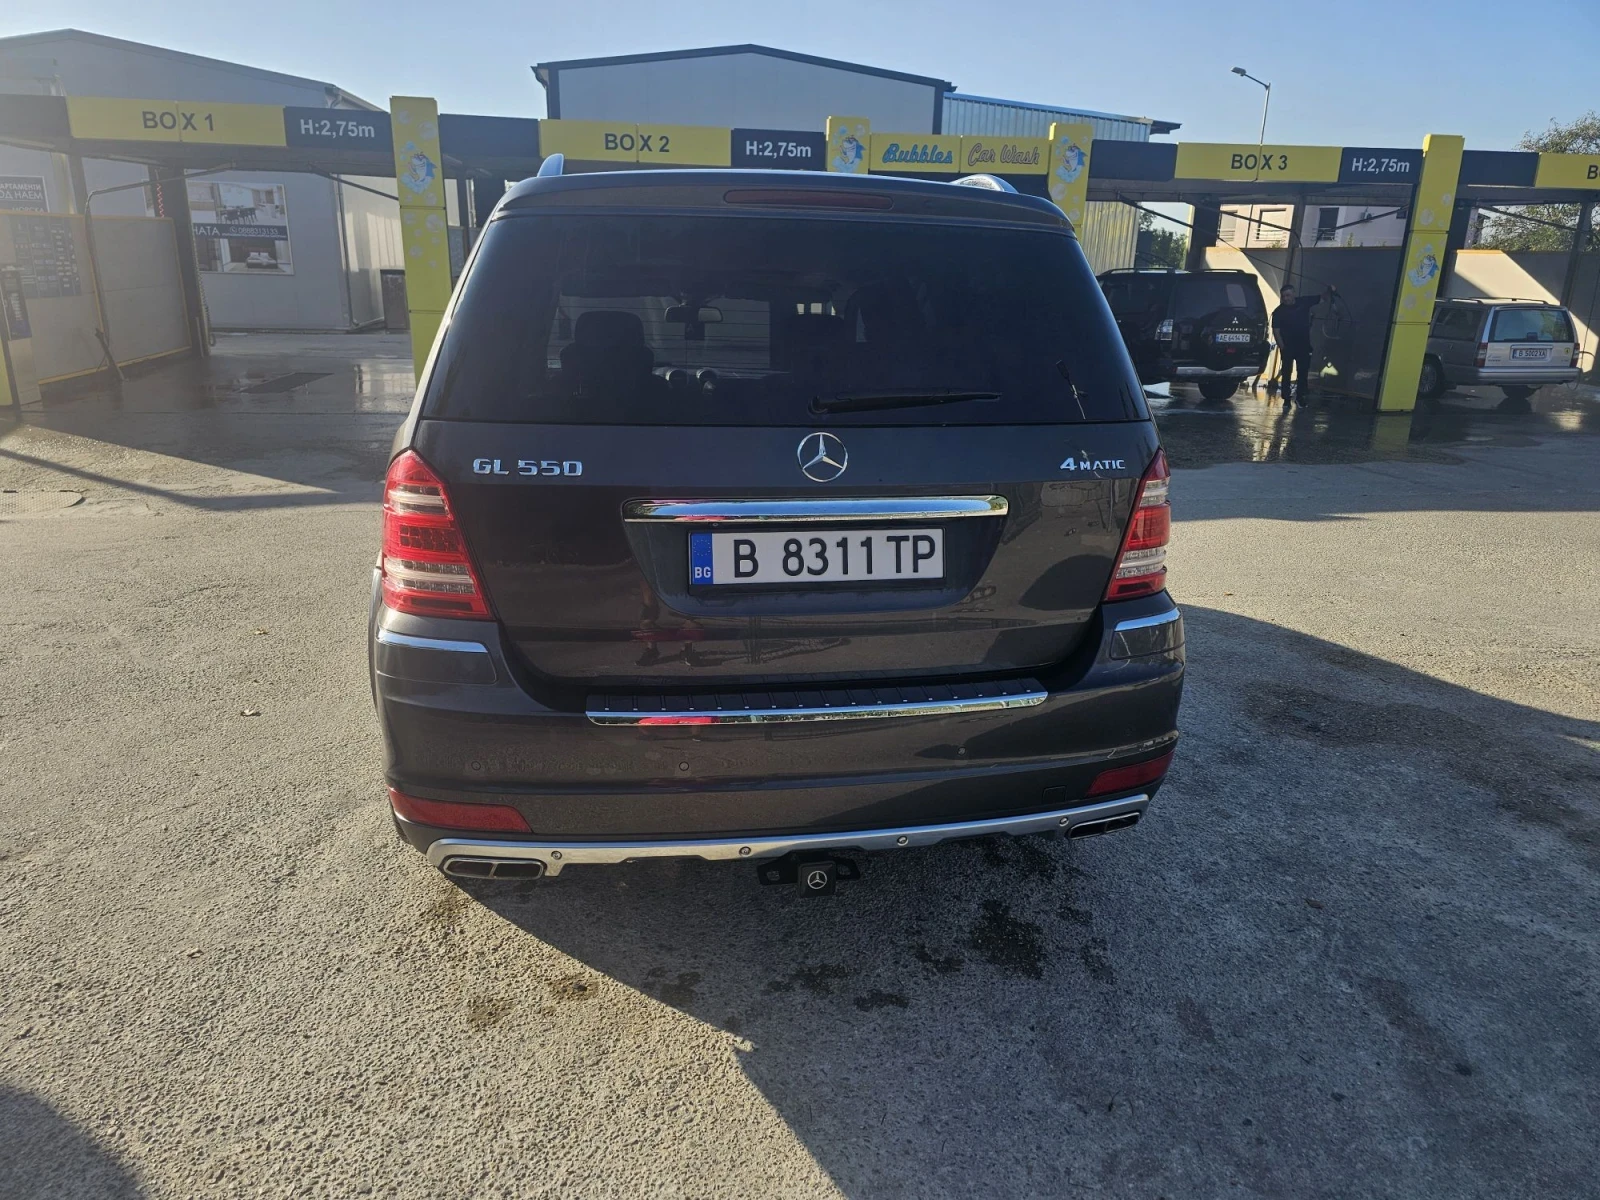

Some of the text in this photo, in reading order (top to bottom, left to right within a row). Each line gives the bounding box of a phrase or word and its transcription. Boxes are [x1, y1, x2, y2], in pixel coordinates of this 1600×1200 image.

[142, 111, 214, 131] BOX 1
[300, 119, 375, 138] H:2,75m
[604, 133, 670, 153] BOX 2
[745, 140, 812, 159] H:2,75m
[882, 143, 953, 163] Bubbles
[968, 143, 1040, 166] Car Wash
[1231, 153, 1288, 171] BOX 3
[1351, 157, 1410, 174] H:2,75m
[473, 458, 583, 476] GL 550
[733, 535, 936, 578] B 8311 TP
[694, 567, 712, 578] BG
